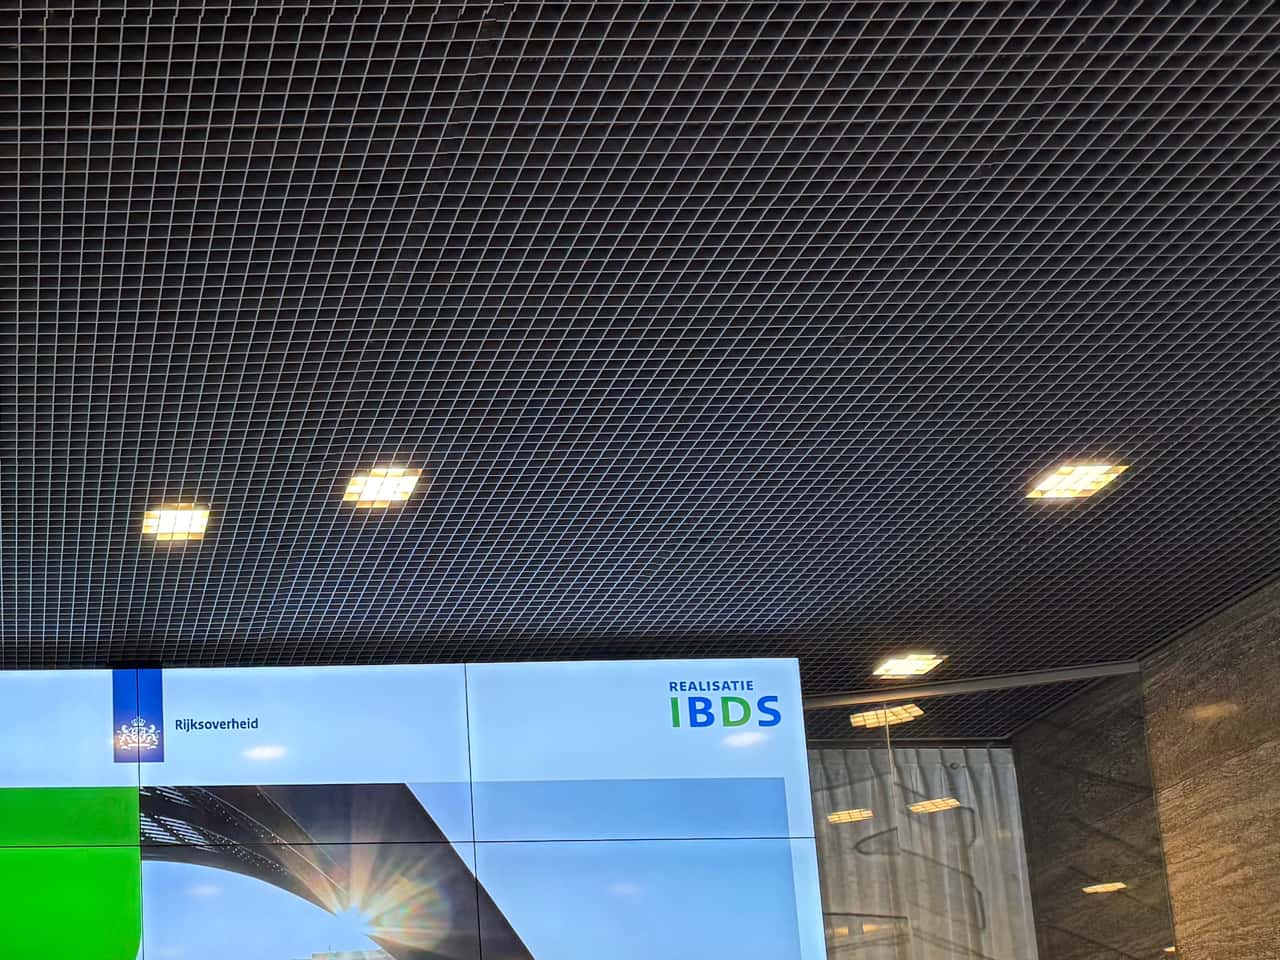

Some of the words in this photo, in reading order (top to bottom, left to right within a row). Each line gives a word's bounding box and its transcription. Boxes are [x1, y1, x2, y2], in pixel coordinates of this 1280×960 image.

[669, 681, 754, 692] REALISATIE
[670, 696, 781, 728] IBDS
[175, 717, 259, 733] Rijksoverheid
